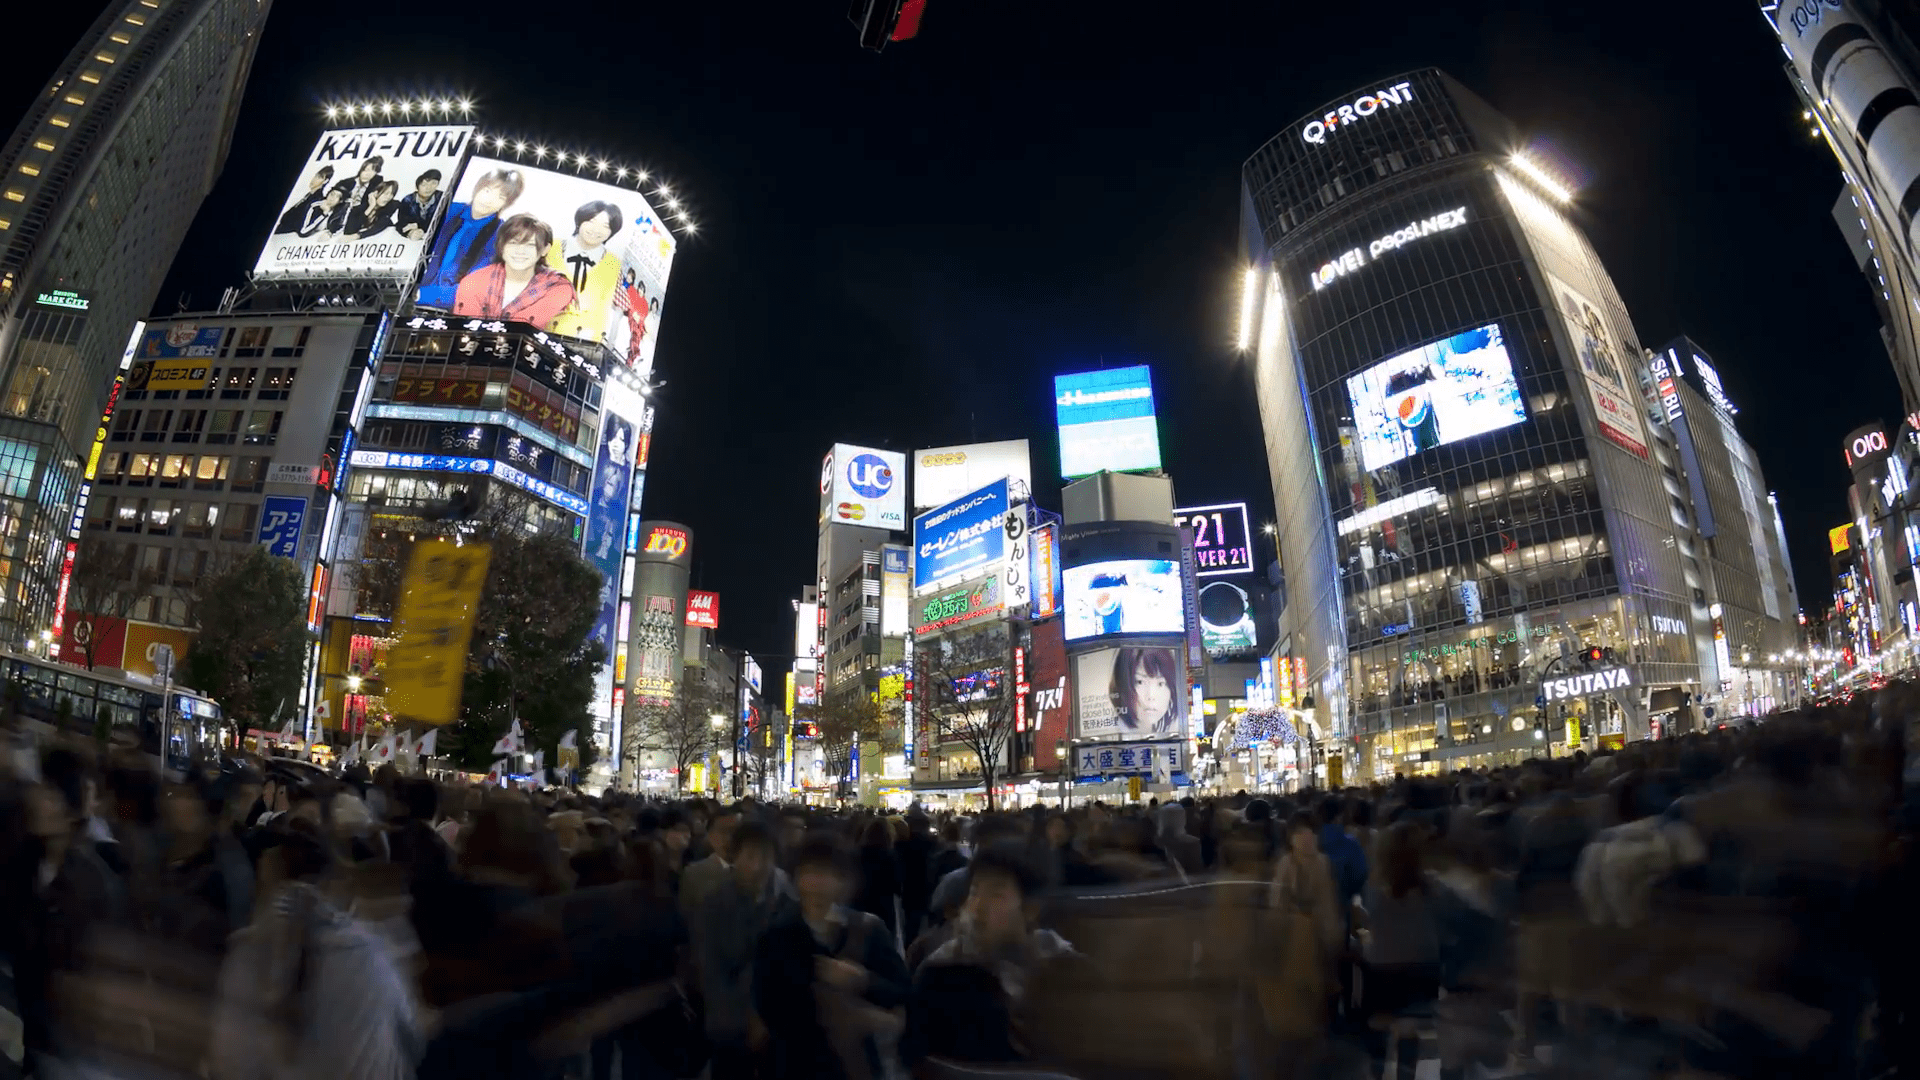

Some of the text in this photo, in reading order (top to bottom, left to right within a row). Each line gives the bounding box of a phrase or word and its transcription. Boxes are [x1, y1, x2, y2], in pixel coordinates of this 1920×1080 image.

[1790, 0, 1819, 38] 109
[1303, 82, 1414, 145] QFRONT
[316, 131, 467, 161] KAT-TUN
[276, 243, 406, 261] CHANGE UR WORLD
[38, 293, 90, 307] MARK CITY
[151, 368, 205, 381] プロミス 4F
[1650, 358, 1683, 421] SEIBU
[507, 386, 577, 437] コンタクト
[880, 512, 901, 521] VISA
[654, 527, 687, 538] SHIBUYA
[645, 533, 688, 560] 109
[1004, 511, 1026, 600] もんじゃ
[1229, 547, 1248, 565] 21
[691, 594, 713, 609] H&M
[1543, 667, 1631, 701] TSUTAYA
